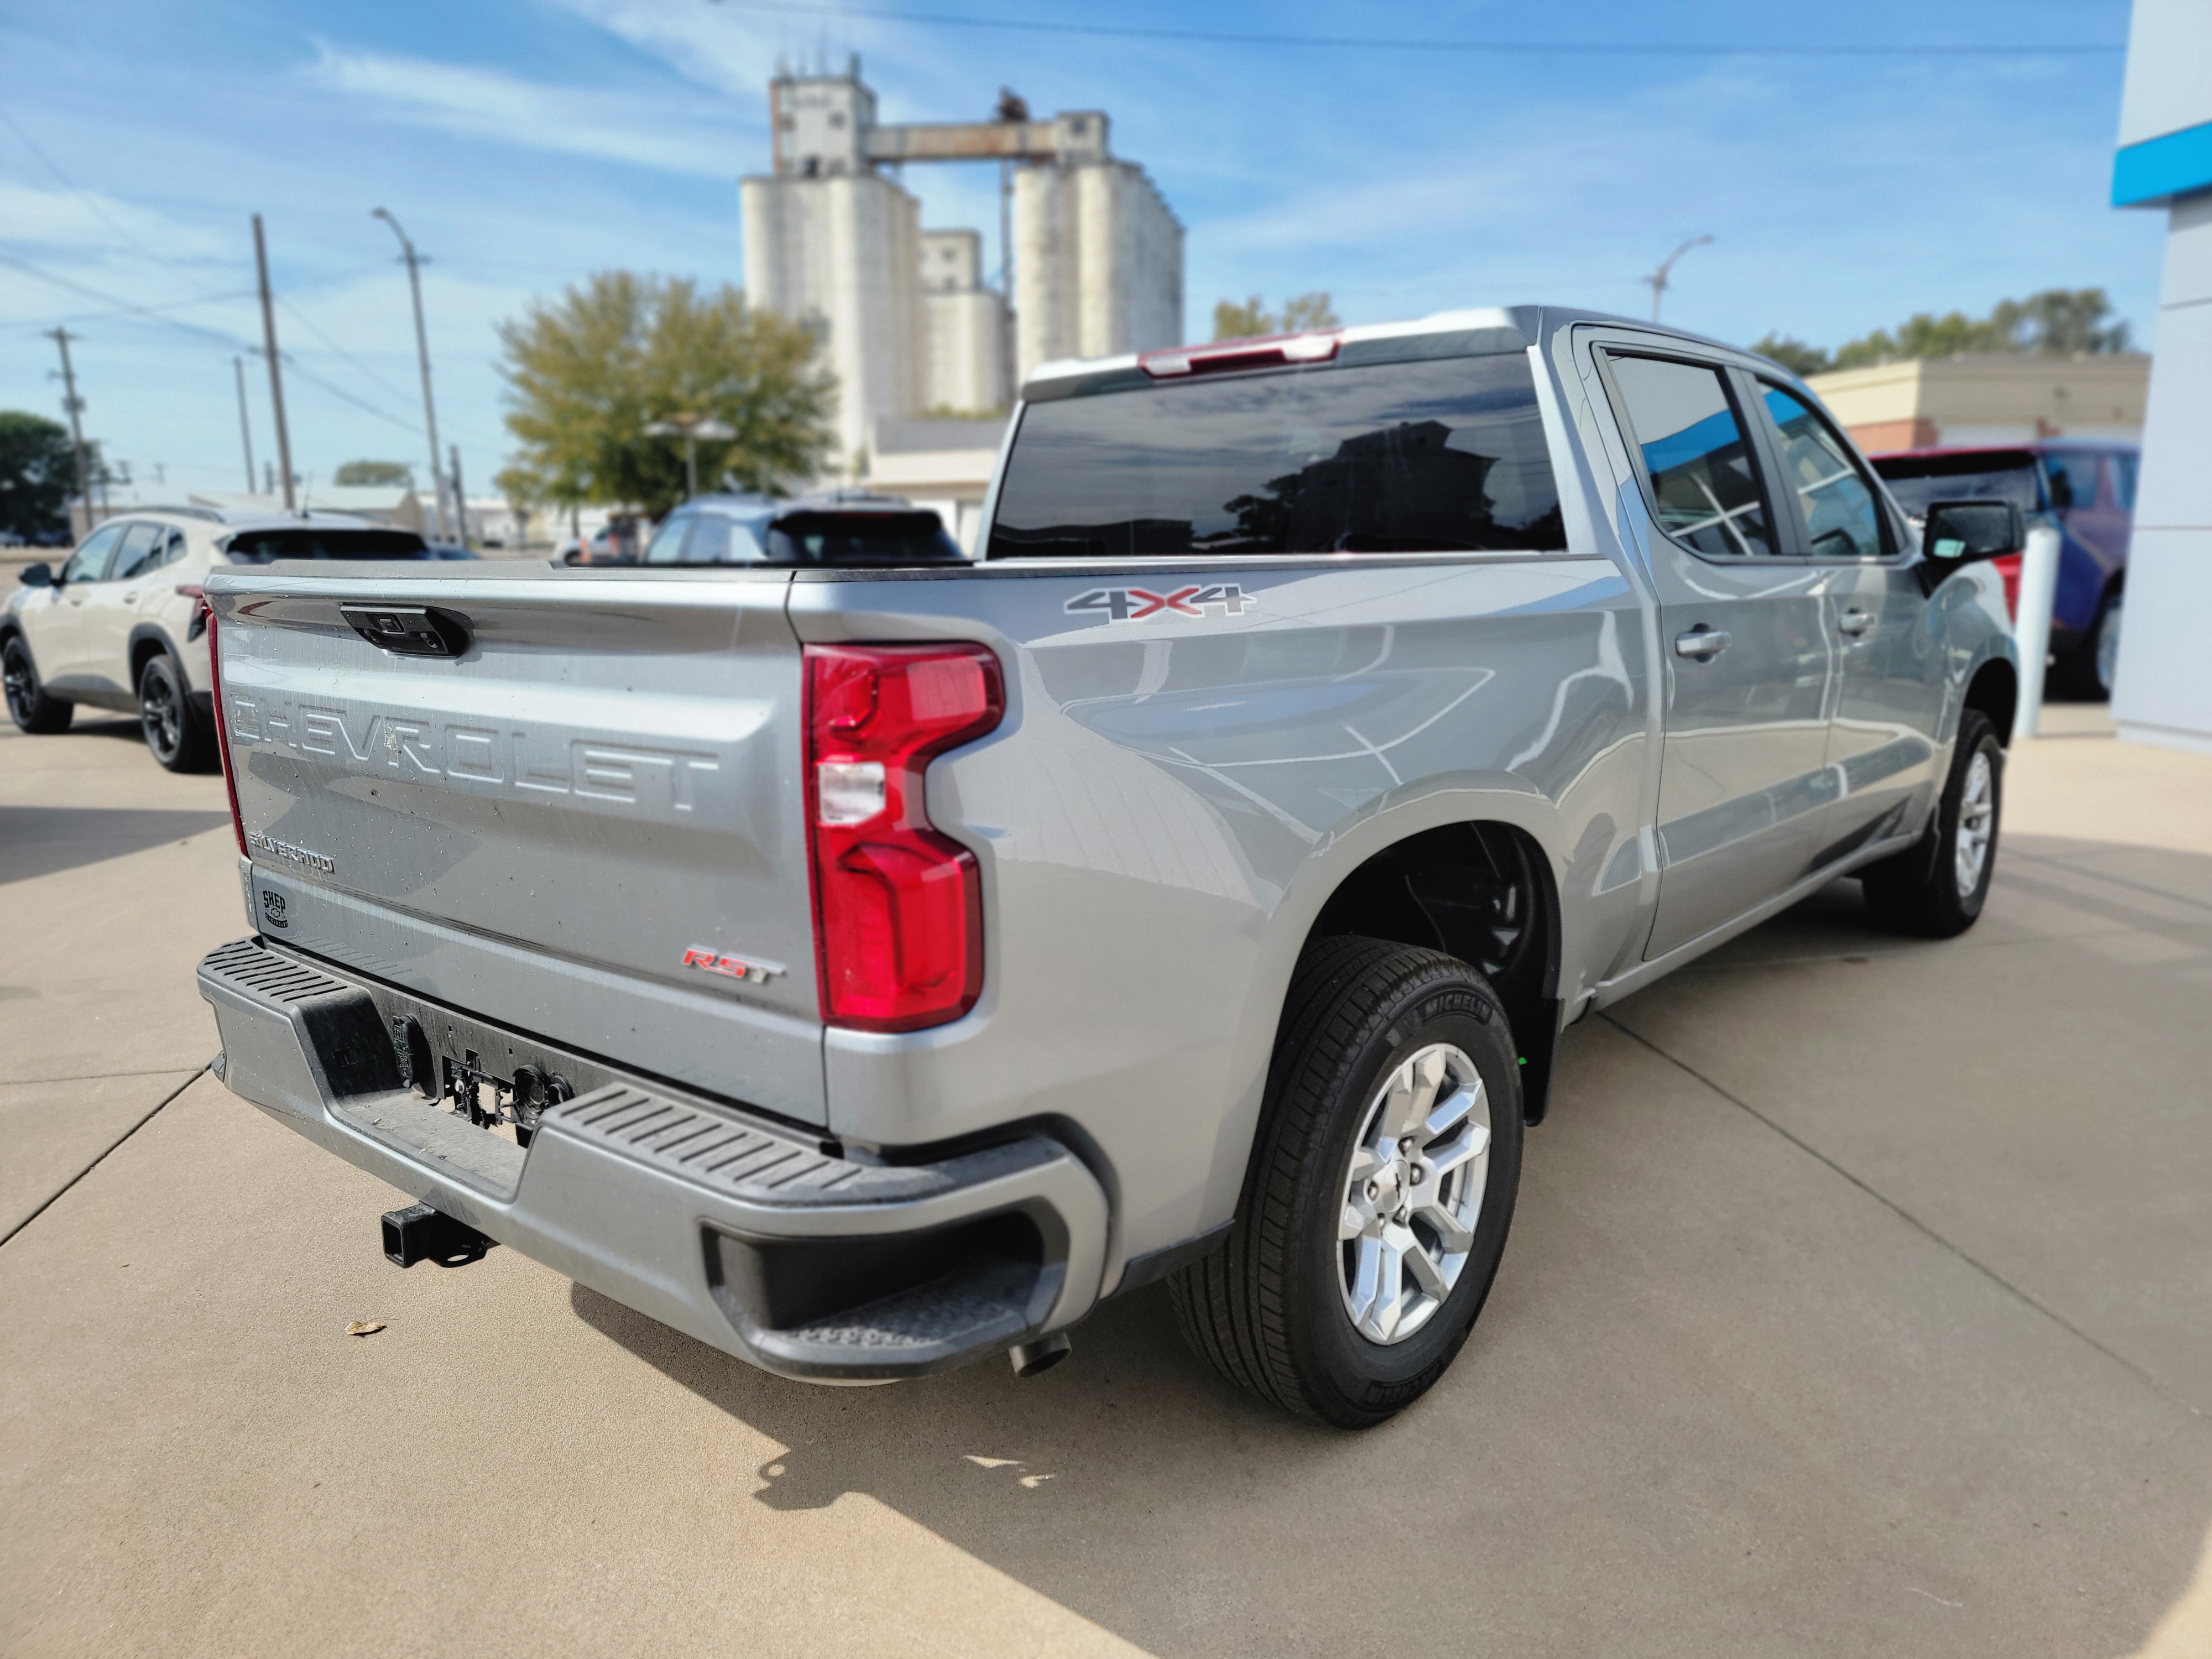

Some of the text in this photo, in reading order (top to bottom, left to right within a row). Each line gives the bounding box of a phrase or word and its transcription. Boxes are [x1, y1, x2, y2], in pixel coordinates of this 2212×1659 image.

[228, 691, 719, 811] CHEVROLET
[249, 831, 335, 874] SILVERADO
[263, 890, 286, 914] SHEP
[265, 914, 288, 927] CHEVROLET
[681, 945, 787, 984] RST
[1425, 994, 1491, 1021] MICHELIN
